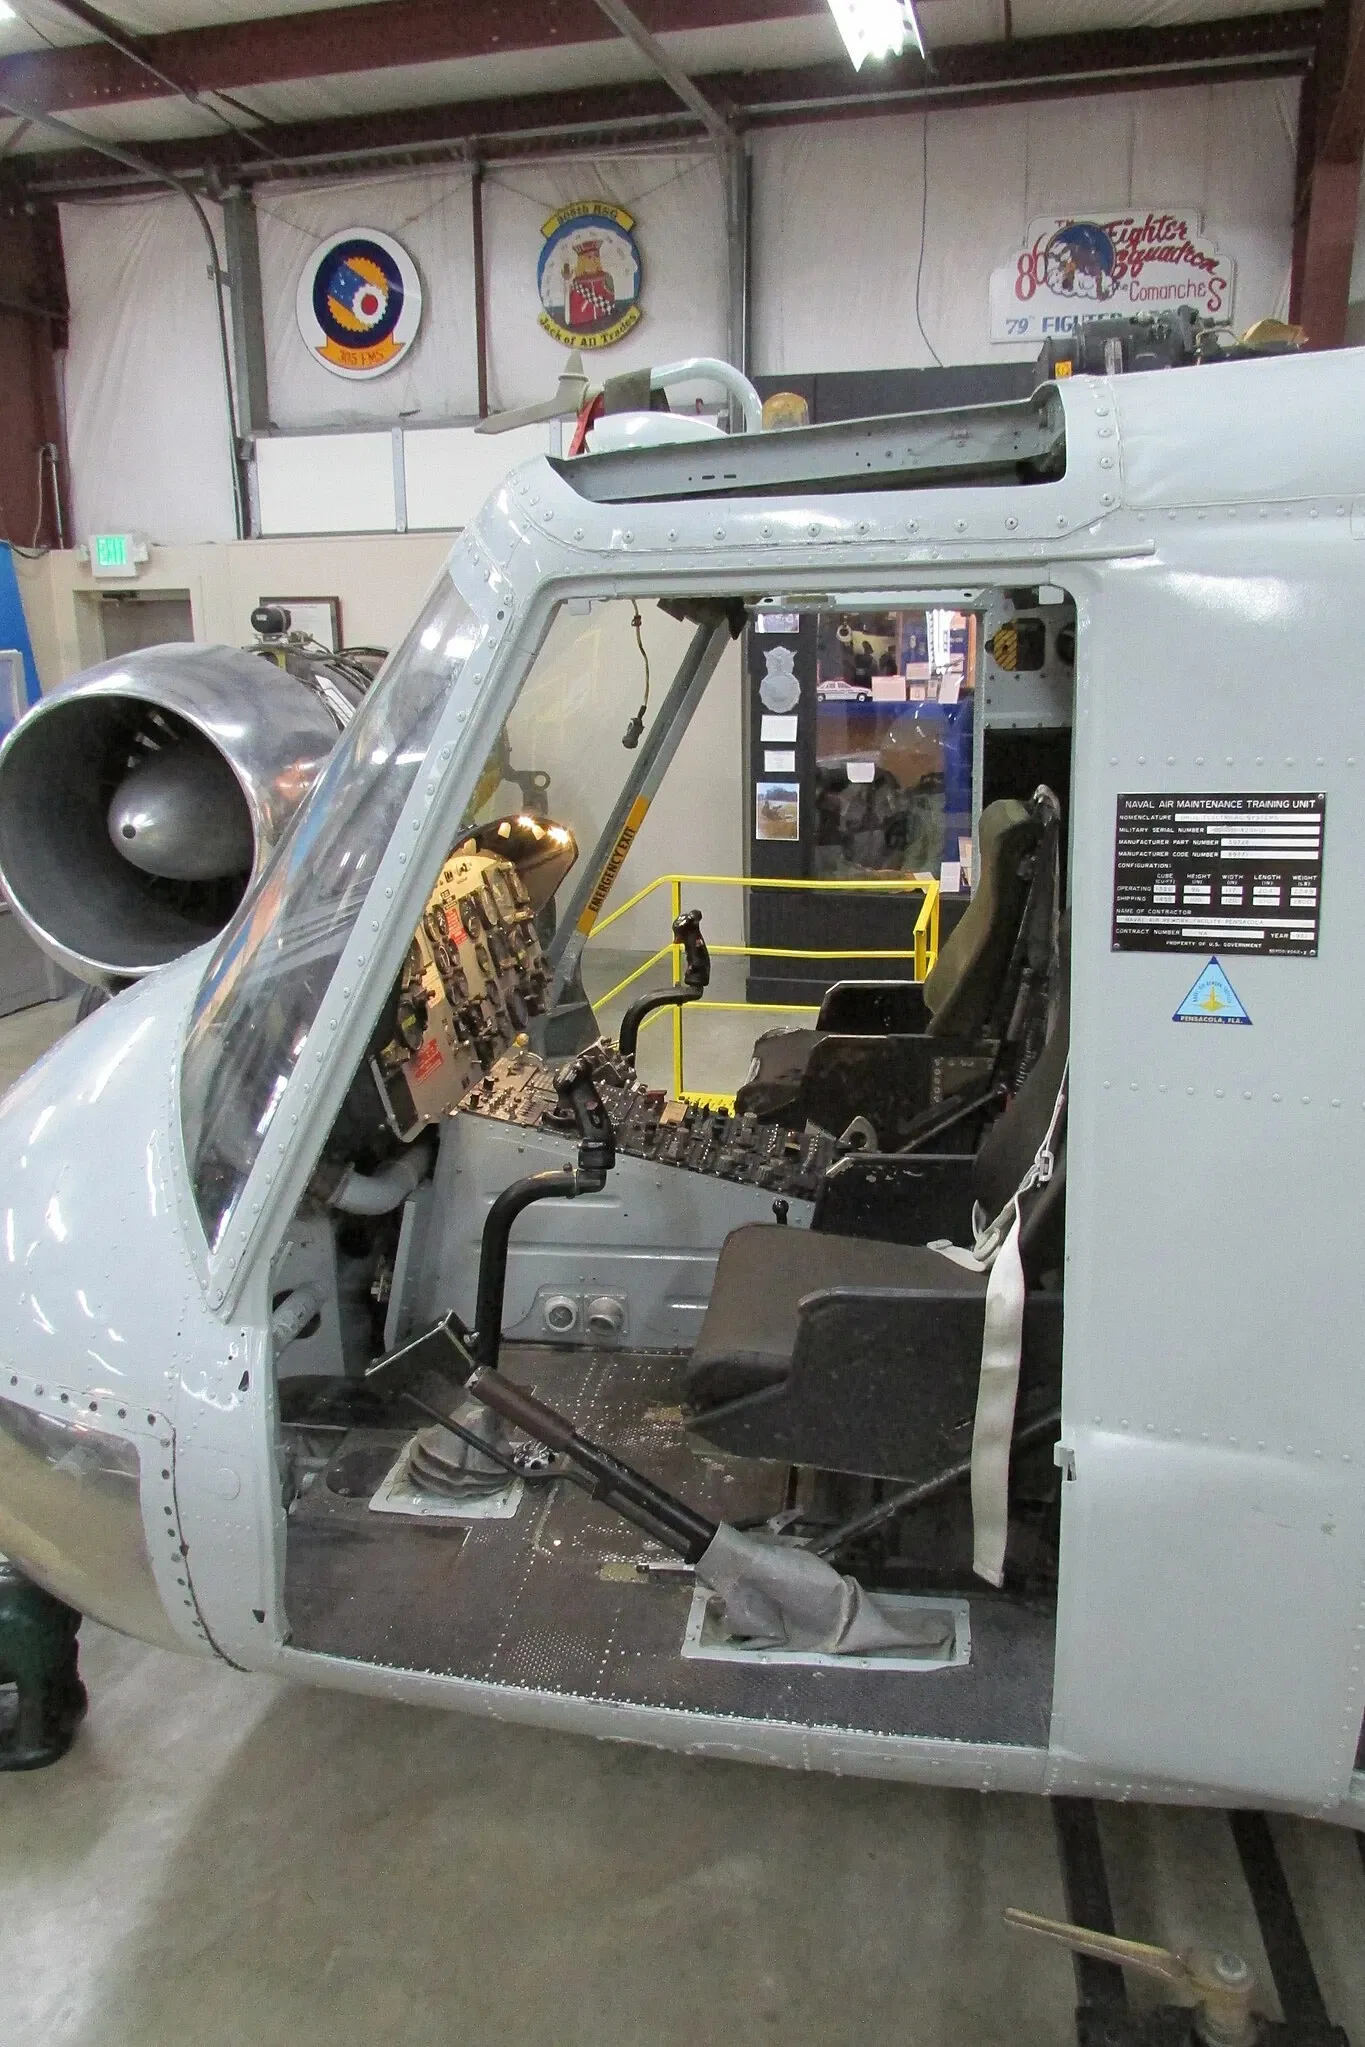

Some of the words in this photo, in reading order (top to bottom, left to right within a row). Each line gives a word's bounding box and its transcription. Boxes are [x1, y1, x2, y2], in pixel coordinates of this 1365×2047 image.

[1103, 214, 1188, 247] Fighter
[1111, 240, 1220, 281] Squadron
[564, 336, 573, 346] of
[580, 337, 597, 347] All
[1125, 800, 1155, 809] NAVAL
[1159, 800, 1174, 809] AIR
[1177, 800, 1243, 809] MAINTENANCE
[1247, 800, 1290, 809] TRAINING
[1292, 800, 1316, 809] UNIT
[587, 846, 625, 913] EMERGENCY
[618, 826, 636, 850] EXIT
